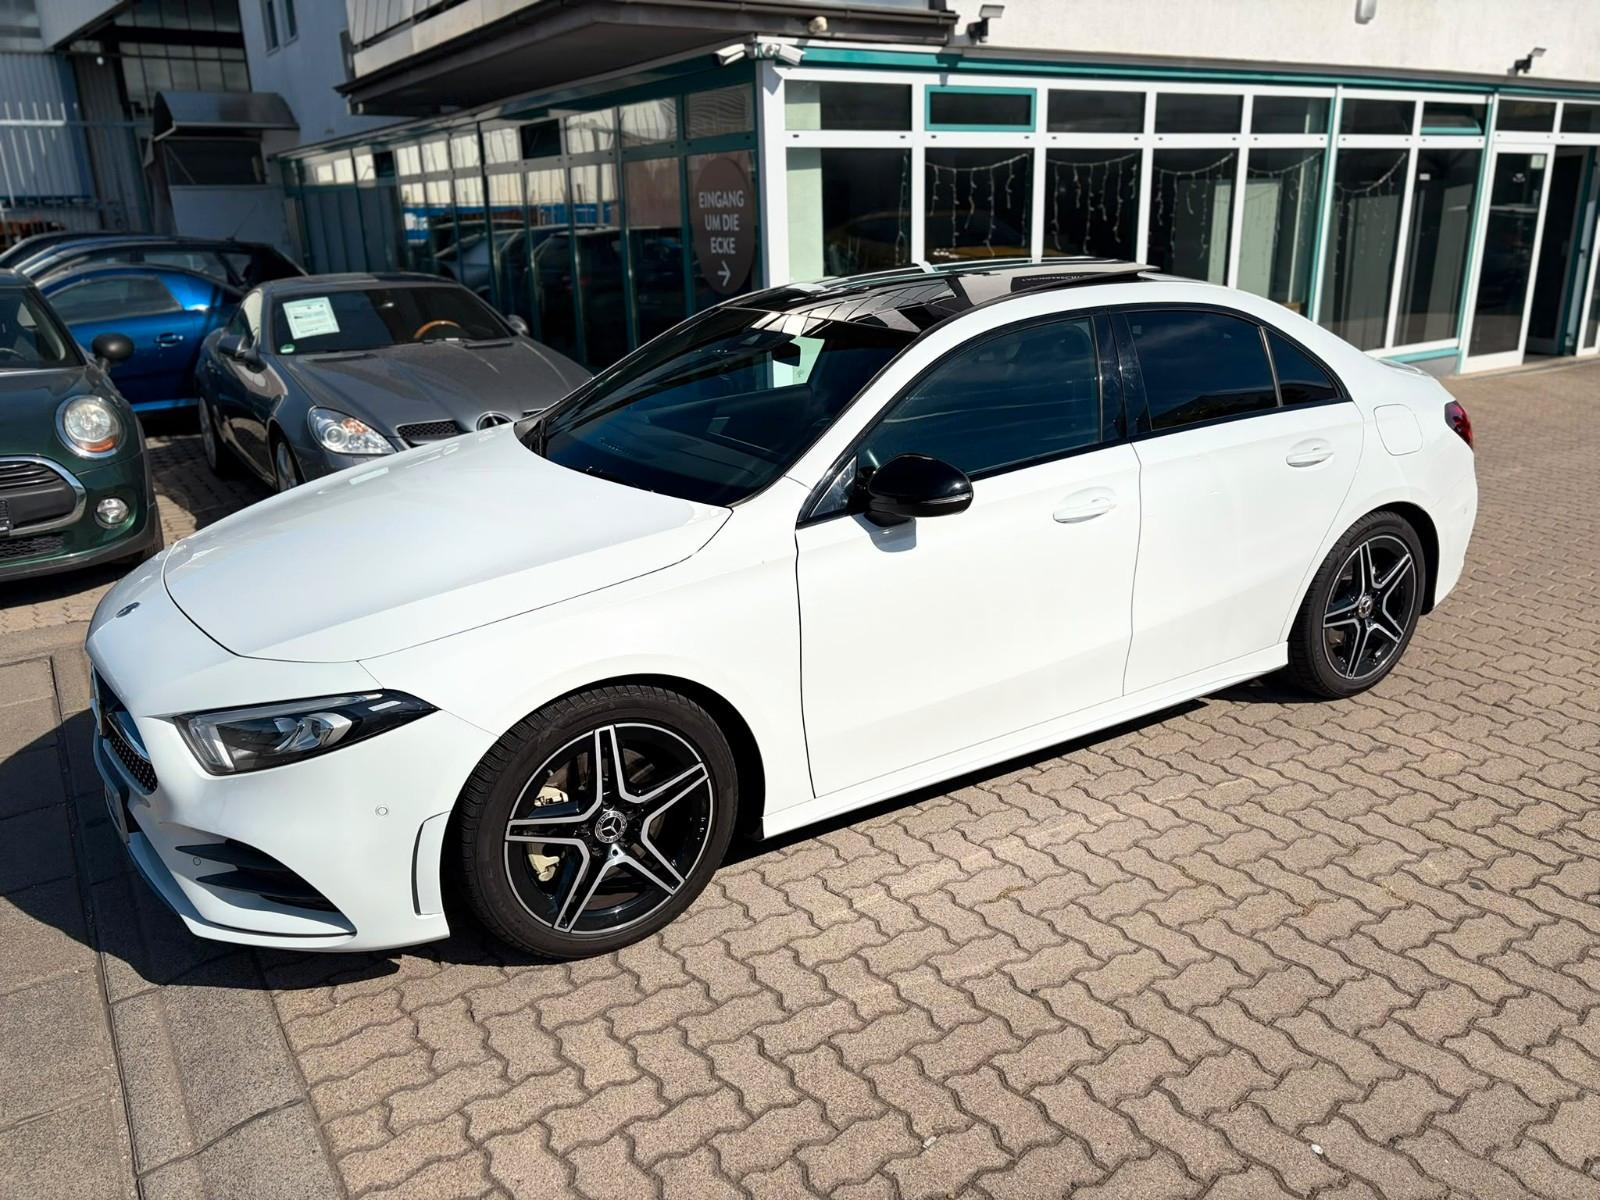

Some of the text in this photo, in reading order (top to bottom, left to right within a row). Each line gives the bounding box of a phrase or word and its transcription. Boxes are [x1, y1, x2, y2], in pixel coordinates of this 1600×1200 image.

[699, 190, 744, 208] EINGANG
[704, 214, 740, 231] UM DIE
[710, 237, 736, 254] ECKE
